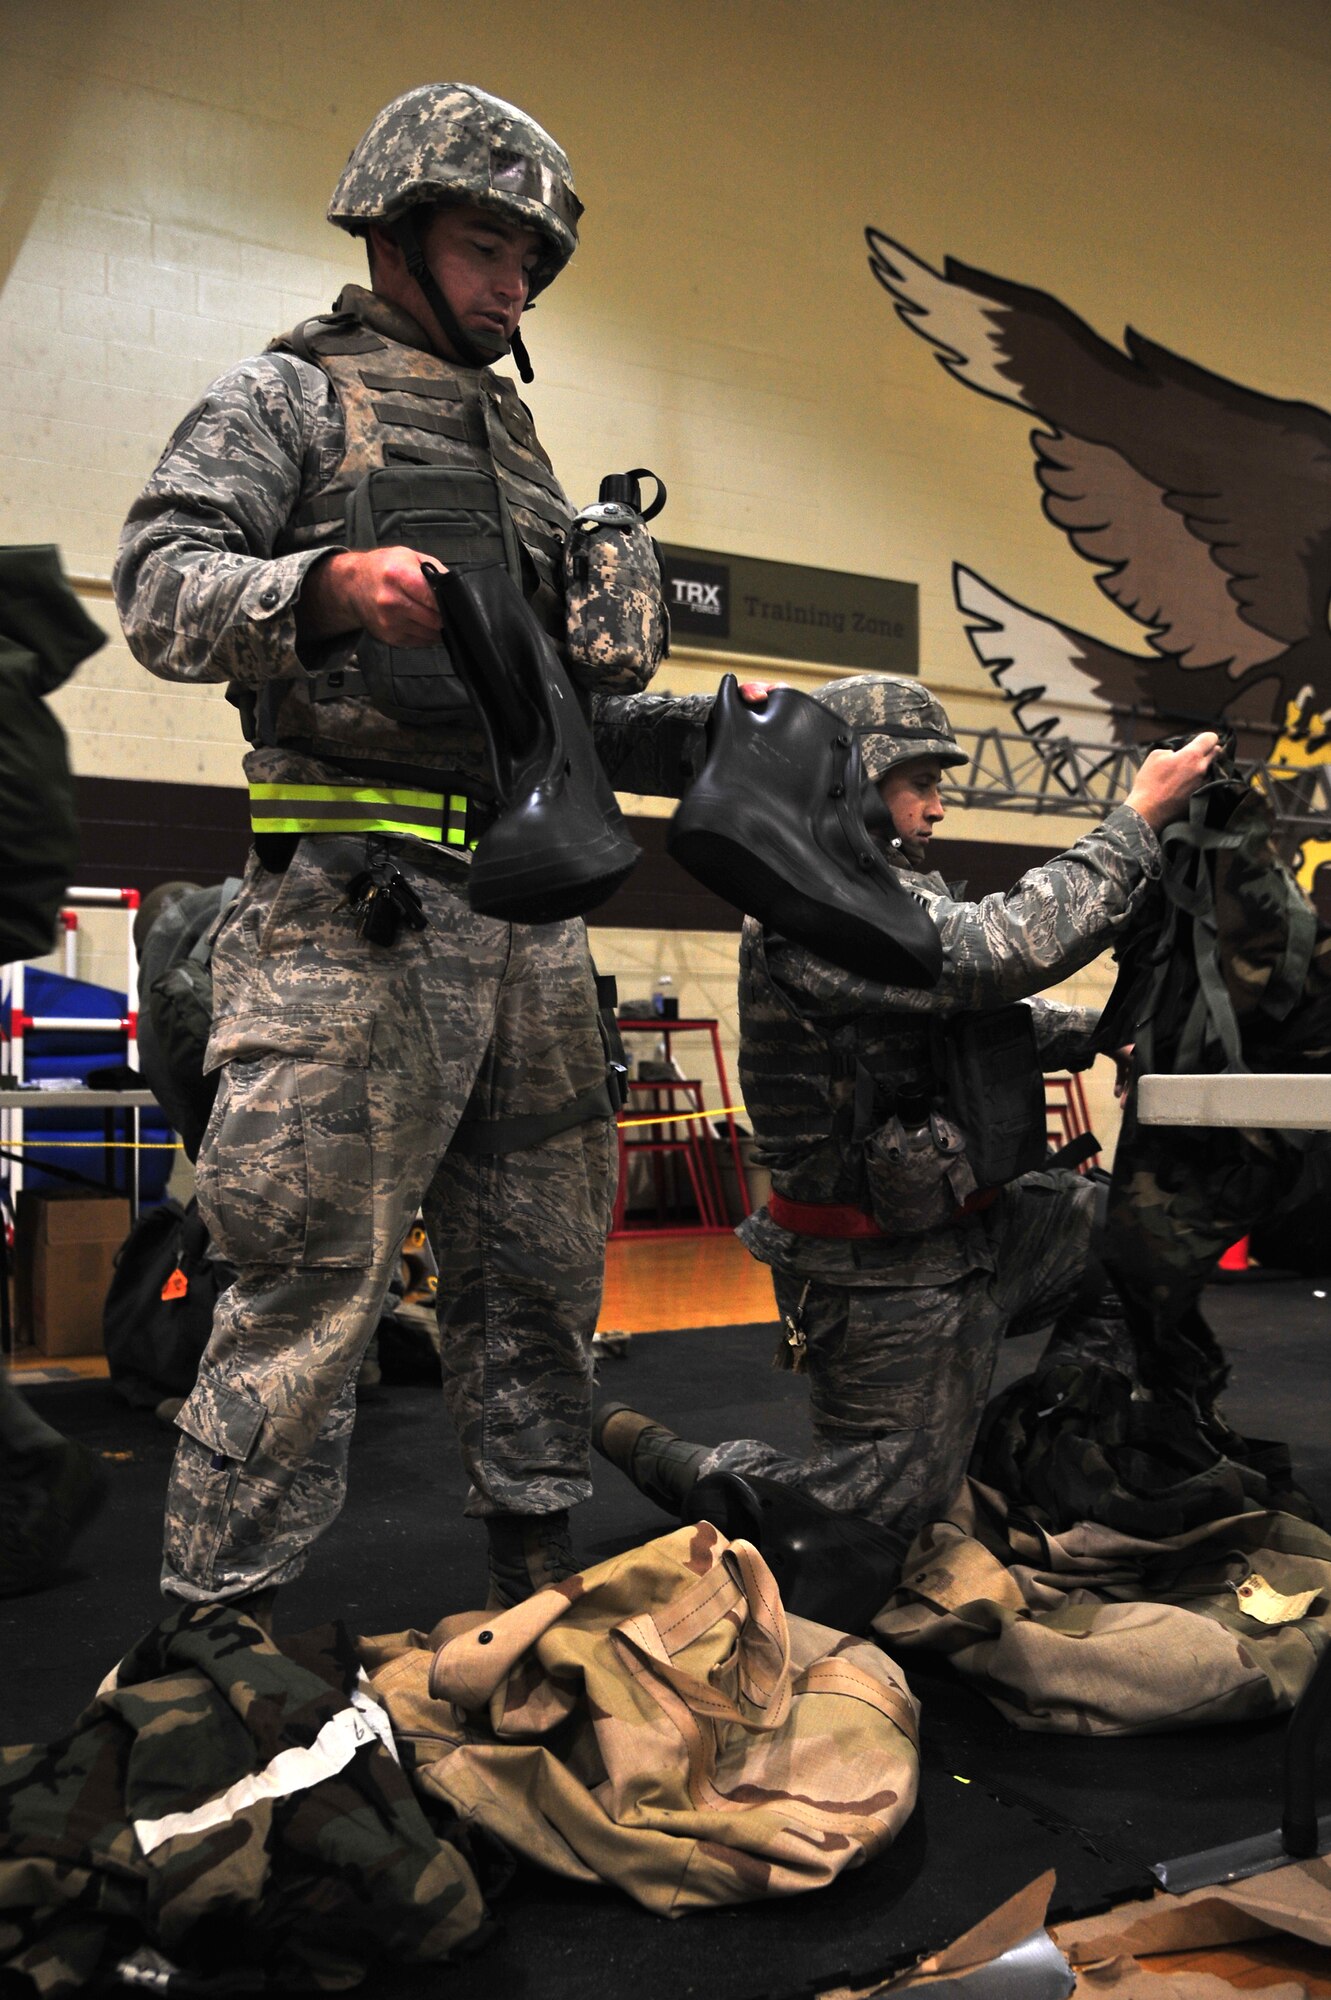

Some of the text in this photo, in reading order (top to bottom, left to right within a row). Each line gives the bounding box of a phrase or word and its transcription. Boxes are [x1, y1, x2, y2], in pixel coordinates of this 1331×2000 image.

[671, 579, 720, 606] TRX
[744, 596, 904, 638] Training Zone
